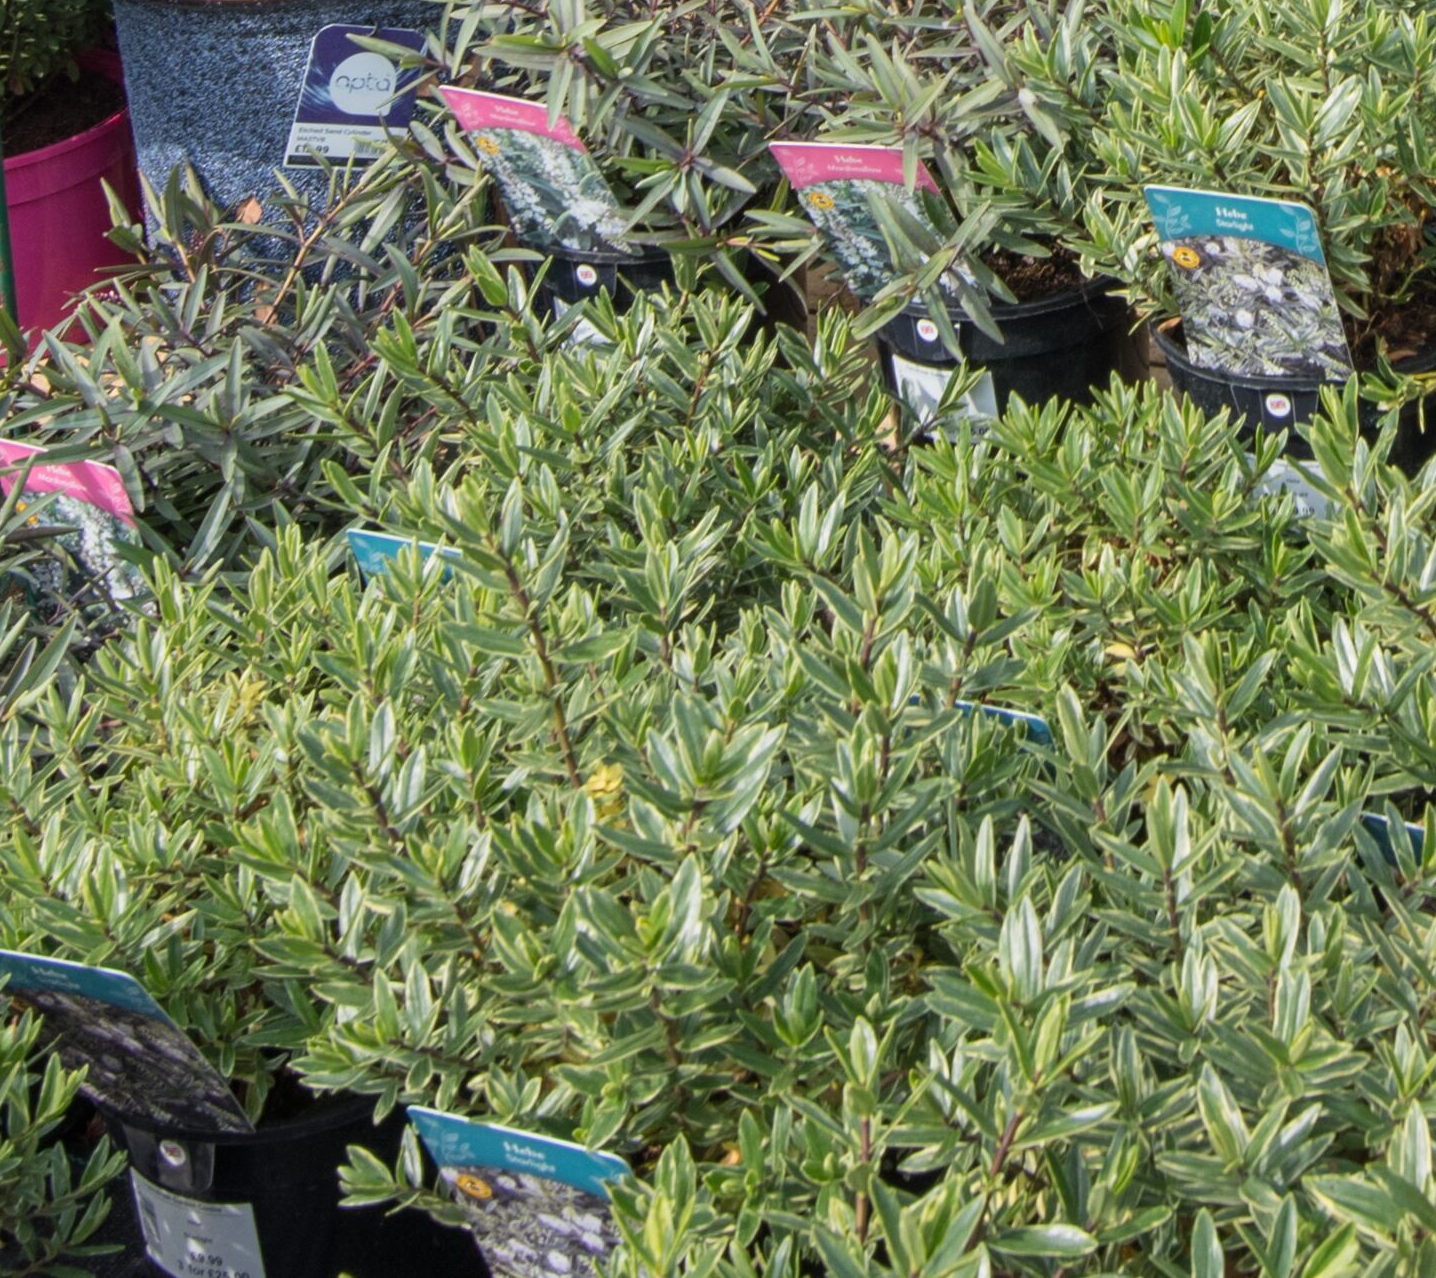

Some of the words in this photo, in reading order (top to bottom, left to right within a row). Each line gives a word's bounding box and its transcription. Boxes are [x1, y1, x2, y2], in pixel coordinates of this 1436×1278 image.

[336, 73, 392, 94] apta
[494, 105, 519, 116] Hebe
[298, 126, 324, 134] Etched
[344, 128, 372, 137] Cylinder
[834, 155, 863, 164] Hebe
[1215, 206, 1248, 220] Hebe
[1216, 218, 1254, 232] Starlight
[504, 1141, 545, 1160] Hebe
[505, 1152, 556, 1173] Starlight
